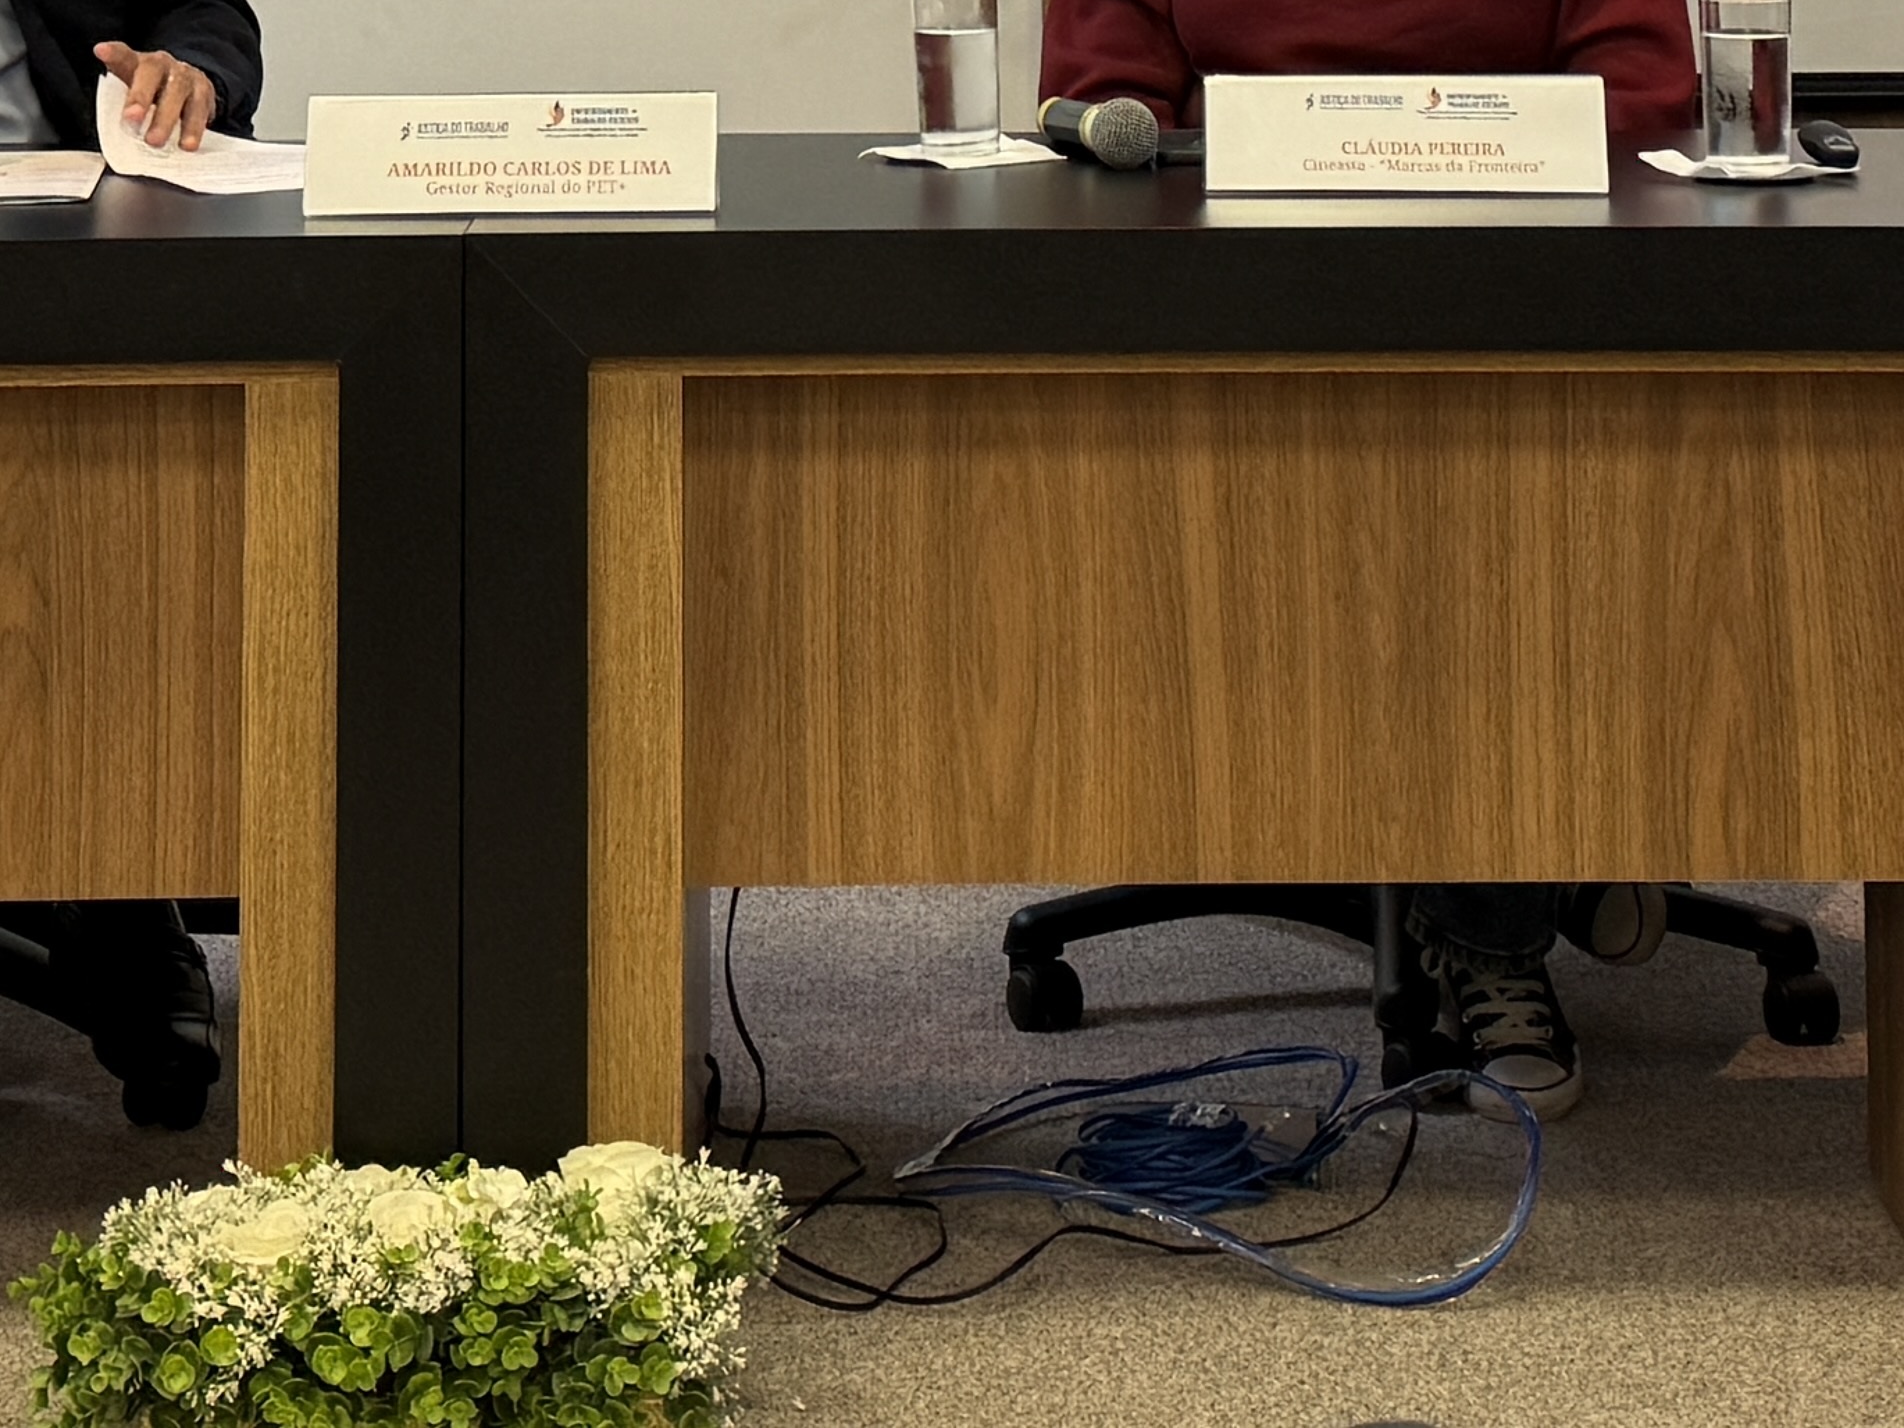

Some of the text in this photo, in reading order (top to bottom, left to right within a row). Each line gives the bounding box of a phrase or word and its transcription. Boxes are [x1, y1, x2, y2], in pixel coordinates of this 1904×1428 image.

[1341, 138, 1506, 156] CLÁUDIA PEREIRA
[387, 159, 673, 178] AMARILDO CARLOS DE LIMA
[1446, 158, 1464, 173] da
[426, 180, 479, 196] Gestor
[485, 180, 557, 198] Regional
[562, 179, 582, 194] do
